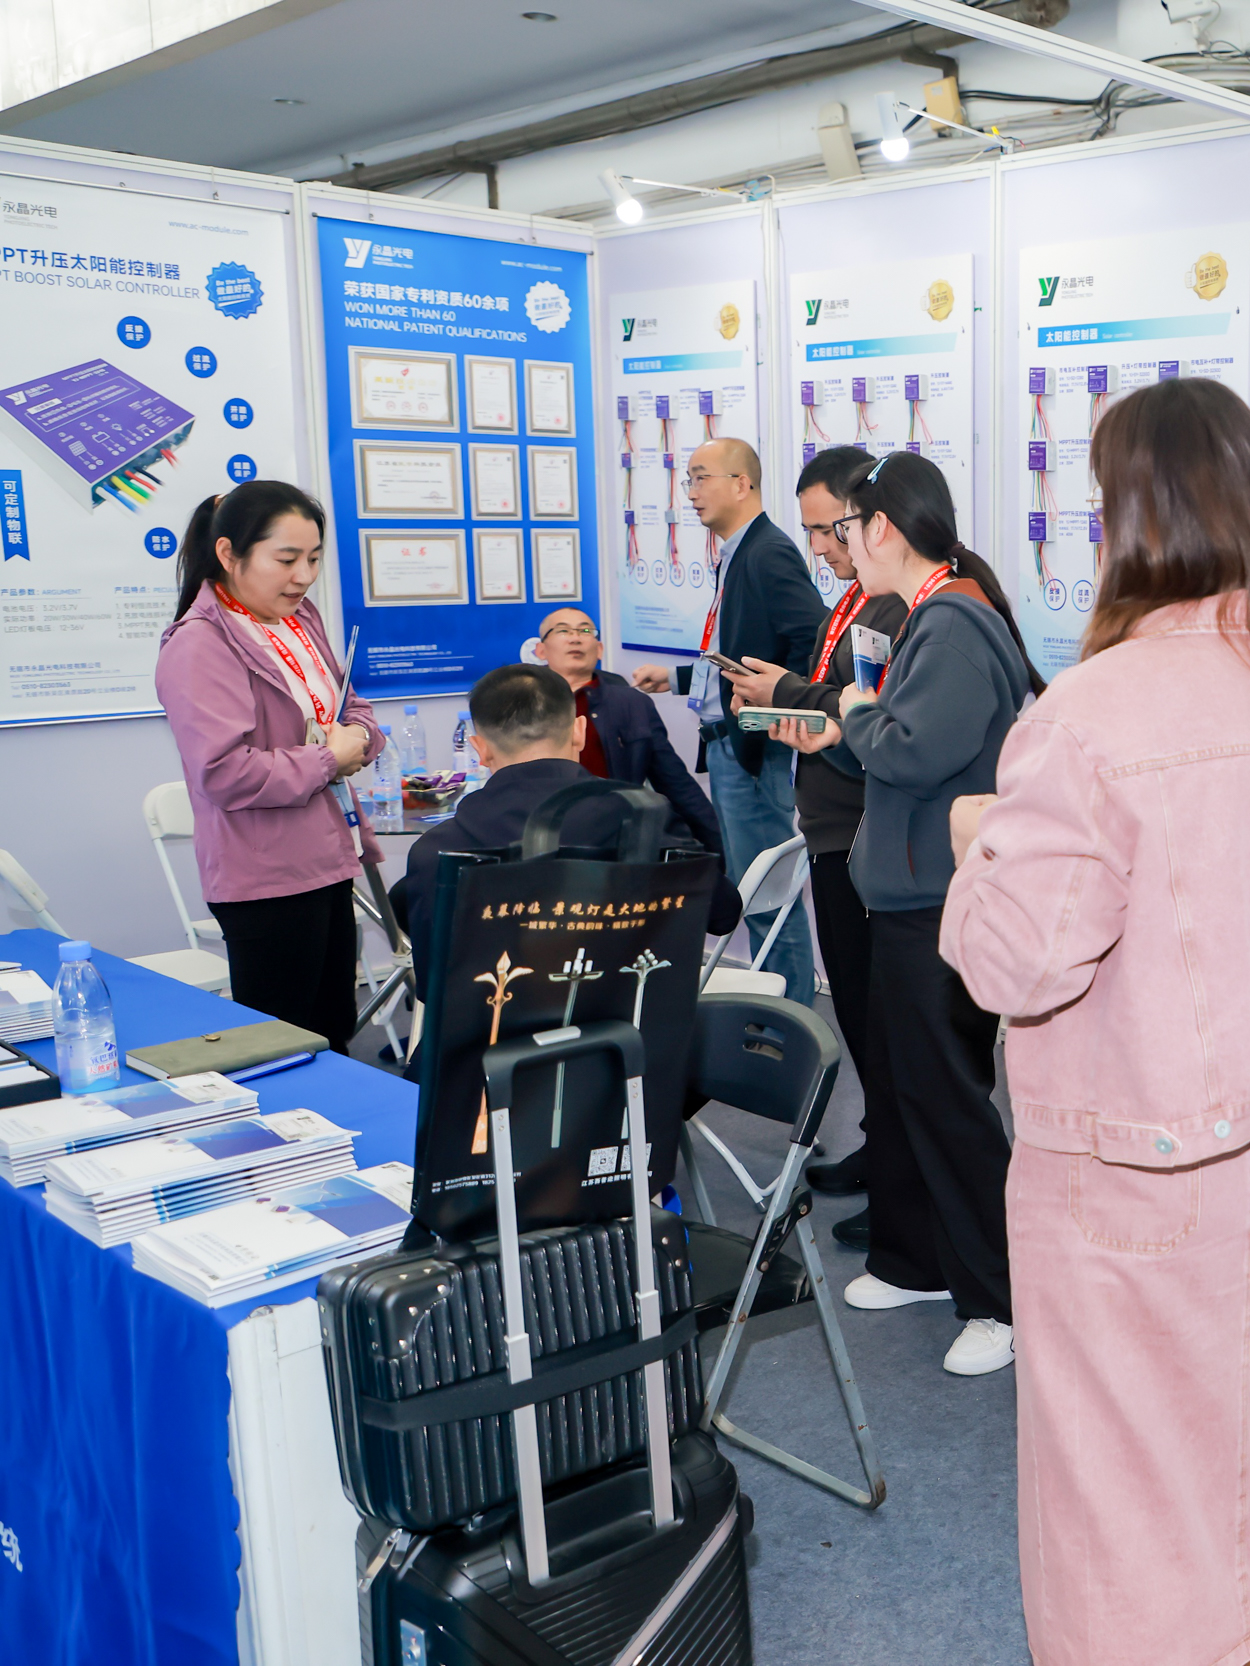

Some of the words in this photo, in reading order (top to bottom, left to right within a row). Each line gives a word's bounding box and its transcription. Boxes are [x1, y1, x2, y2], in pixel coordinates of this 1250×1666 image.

[3, 200, 57, 219] 永晶光电
[168, 219, 249, 236] www.ac-module.com
[372, 244, 414, 260] 永晶光电
[0, 247, 181, 281] PT升压太阳能控制器
[14, 270, 63, 286] BOOST
[66, 274, 112, 291] SOLAR
[116, 280, 200, 300] CONTROLLER
[1061, 275, 1094, 290] 永晶光电
[344, 280, 510, 312] 荣获国家专利资质60余项
[344, 301, 373, 314] WON
[375, 303, 408, 317] MORE
[410, 307, 440, 320] THAN
[442, 310, 456, 321] 60
[345, 317, 402, 332] NATIONAL
[404, 321, 444, 335] PATENT
[446, 325, 527, 343] QUALIFICATIONS
[1046, 327, 1098, 344] 太阳能控制器
[2, 480, 22, 545] 可定制物联
